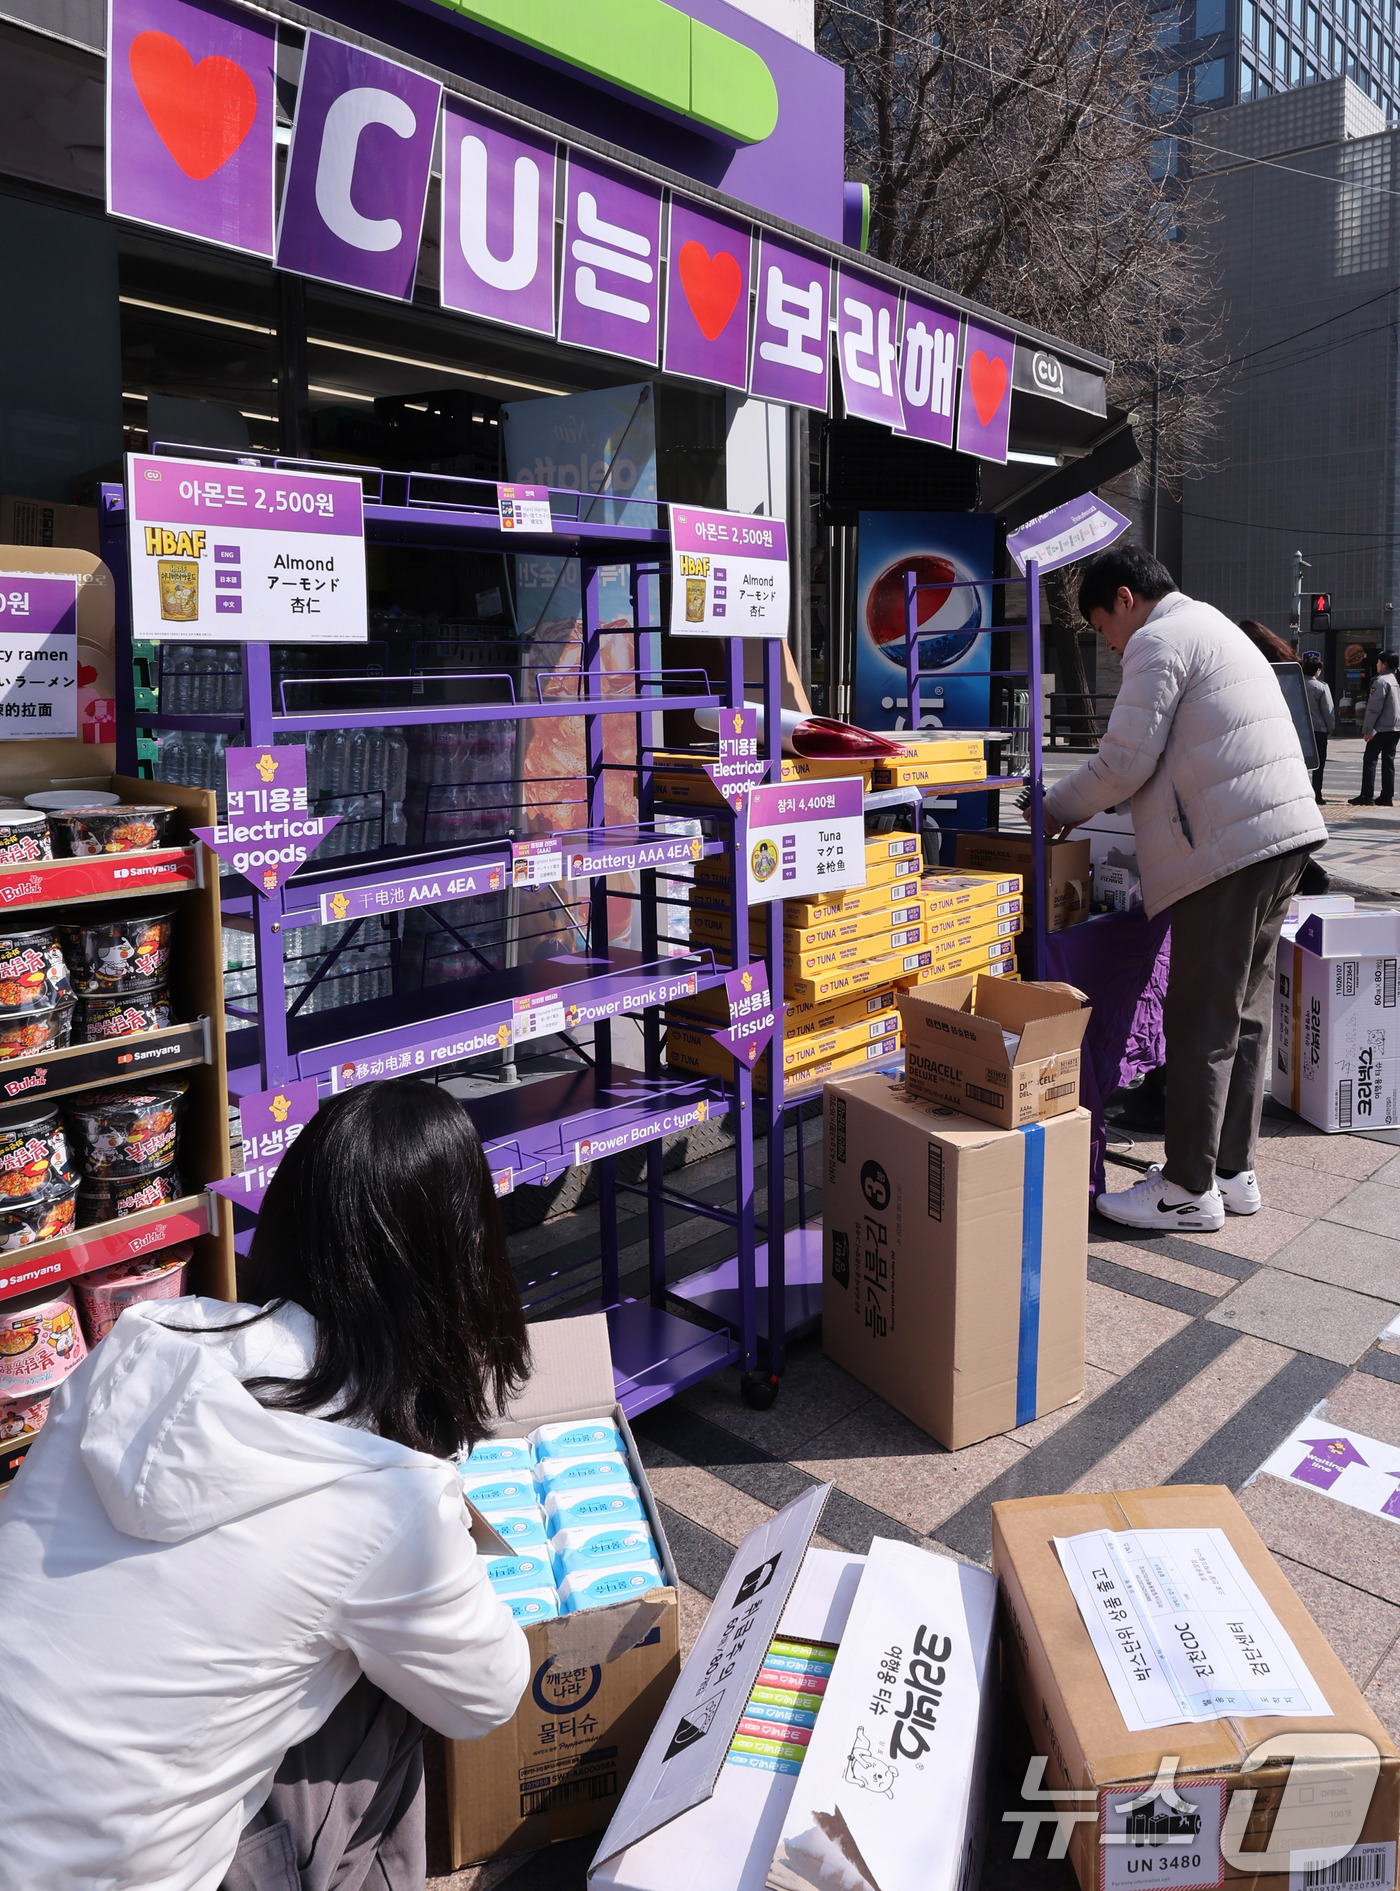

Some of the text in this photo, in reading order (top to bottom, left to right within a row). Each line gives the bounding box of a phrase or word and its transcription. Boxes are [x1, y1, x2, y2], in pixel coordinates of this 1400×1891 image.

[314, 87, 953, 417] CU는 보라해
[1036, 359, 1058, 385] CU
[179, 480, 335, 518] 아몬드 2,500원
[145, 526, 206, 558] HBAF
[695, 522, 773, 547] 아몬드 2,500원
[220, 551, 234, 559] ENG
[274, 554, 334, 572] Almond
[680, 555, 710, 577] HBAF
[220, 576, 237, 584] 日本語
[267, 576, 340, 594] アーモンド
[743, 574, 773, 586] Almond
[739, 590, 776, 601] アーモンド
[290, 597, 321, 614] 杏仁
[750, 606, 765, 617] 杏仁
[18, 650, 68, 661] ramen
[0, 703, 52, 717] 的拉面
[719, 738, 757, 758] 전기용품
[713, 760, 764, 778] Electrical
[791, 764, 810, 775] TUNA
[912, 771, 929, 780] TUNA
[722, 779, 755, 799] goods
[228, 787, 308, 815] 전기용품
[777, 795, 836, 814] 참치 4,400원
[213, 817, 324, 844] Electrical
[819, 831, 841, 843] Tuna
[233, 844, 307, 873] goods
[583, 844, 691, 872] Battery AAA 4EA
[816, 846, 844, 857] マグロ
[816, 860, 846, 875] 金枪鱼
[0, 863, 177, 902] Buldak Samyang
[359, 876, 476, 909] 干电池 AAA 4EA
[823, 905, 840, 916] TUNA
[938, 898, 953, 909] TUNA
[940, 921, 955, 931] TUNA
[817, 930, 836, 941] TUNA
[941, 941, 955, 951] TUNA
[817, 953, 836, 965] TUNA
[930, 965, 946, 976] TUNA
[830, 978, 849, 990] TUNA
[576, 1000, 620, 1022] Power
[623, 991, 658, 1010] Bank
[659, 986, 667, 1000] 8
[669, 981, 690, 1001] pin
[729, 990, 771, 1021] 위생용품
[796, 1002, 814, 1014] TUNA
[87, 1007, 146, 1035] 불닭볶음면
[728, 1013, 774, 1042] Tissue
[797, 1023, 815, 1036] TUNA
[1311, 996, 1321, 1066] 크리넥스
[355, 1031, 497, 1080] 移动电源 8 reusable
[680, 1054, 699, 1066] TUNA
[796, 1047, 816, 1060] TUNA
[4, 1044, 181, 1096] Buldak Samyang
[792, 1069, 811, 1082] TUNA
[909, 1053, 962, 1082] DURACELL
[909, 1066, 938, 1083] DELUXE
[1358, 1047, 1373, 1117] 크리넥스
[1374, 1061, 1382, 1100] 여행용 티슈
[590, 1110, 699, 1154] Power Bank C type
[124, 1130, 177, 1161] 불닭볶음면
[117, 1176, 171, 1209] 불닭볶음면
[9, 1231, 166, 1286] Samyang Buldak
[834, 1242, 847, 1273] 양반
[863, 1215, 888, 1338] 들기름김
[1307, 1454, 1345, 1473] Waiting
[1312, 1461, 1332, 1473] line
[472, 1490, 500, 1500] 물티슈
[579, 1503, 607, 1514] 물티슈
[589, 1540, 621, 1552] 물티슈
[595, 1580, 627, 1593] 물티슈
[1092, 1567, 1115, 1593] 출고
[1103, 1597, 1127, 1622] 상품
[792, 1645, 828, 1657] 크리넥스
[1115, 1627, 1152, 1681] 박스단위
[1174, 1622, 1215, 1678] 진천CDC
[1226, 1622, 1271, 1676] 검단센터
[787, 1661, 824, 1673] 크리넥스
[546, 1667, 587, 1686] 깨끗한
[780, 1675, 817, 1688] 크리넥스
[869, 1646, 903, 1716] 여행용 티슈
[553, 1683, 581, 1699] 나라
[889, 1624, 953, 1762] 크리넥스
[775, 1694, 813, 1708] 크리넥스
[766, 1709, 804, 1722] 크리넥스
[537, 1713, 598, 1745] 물티슈
[762, 1726, 801, 1739] 크리넥스
[755, 1742, 795, 1756] 크리넥스
[750, 1758, 790, 1772] 크리넥스
[1362, 1846, 1387, 1855] DPB26C
[1127, 1854, 1201, 1873] UN 3480
